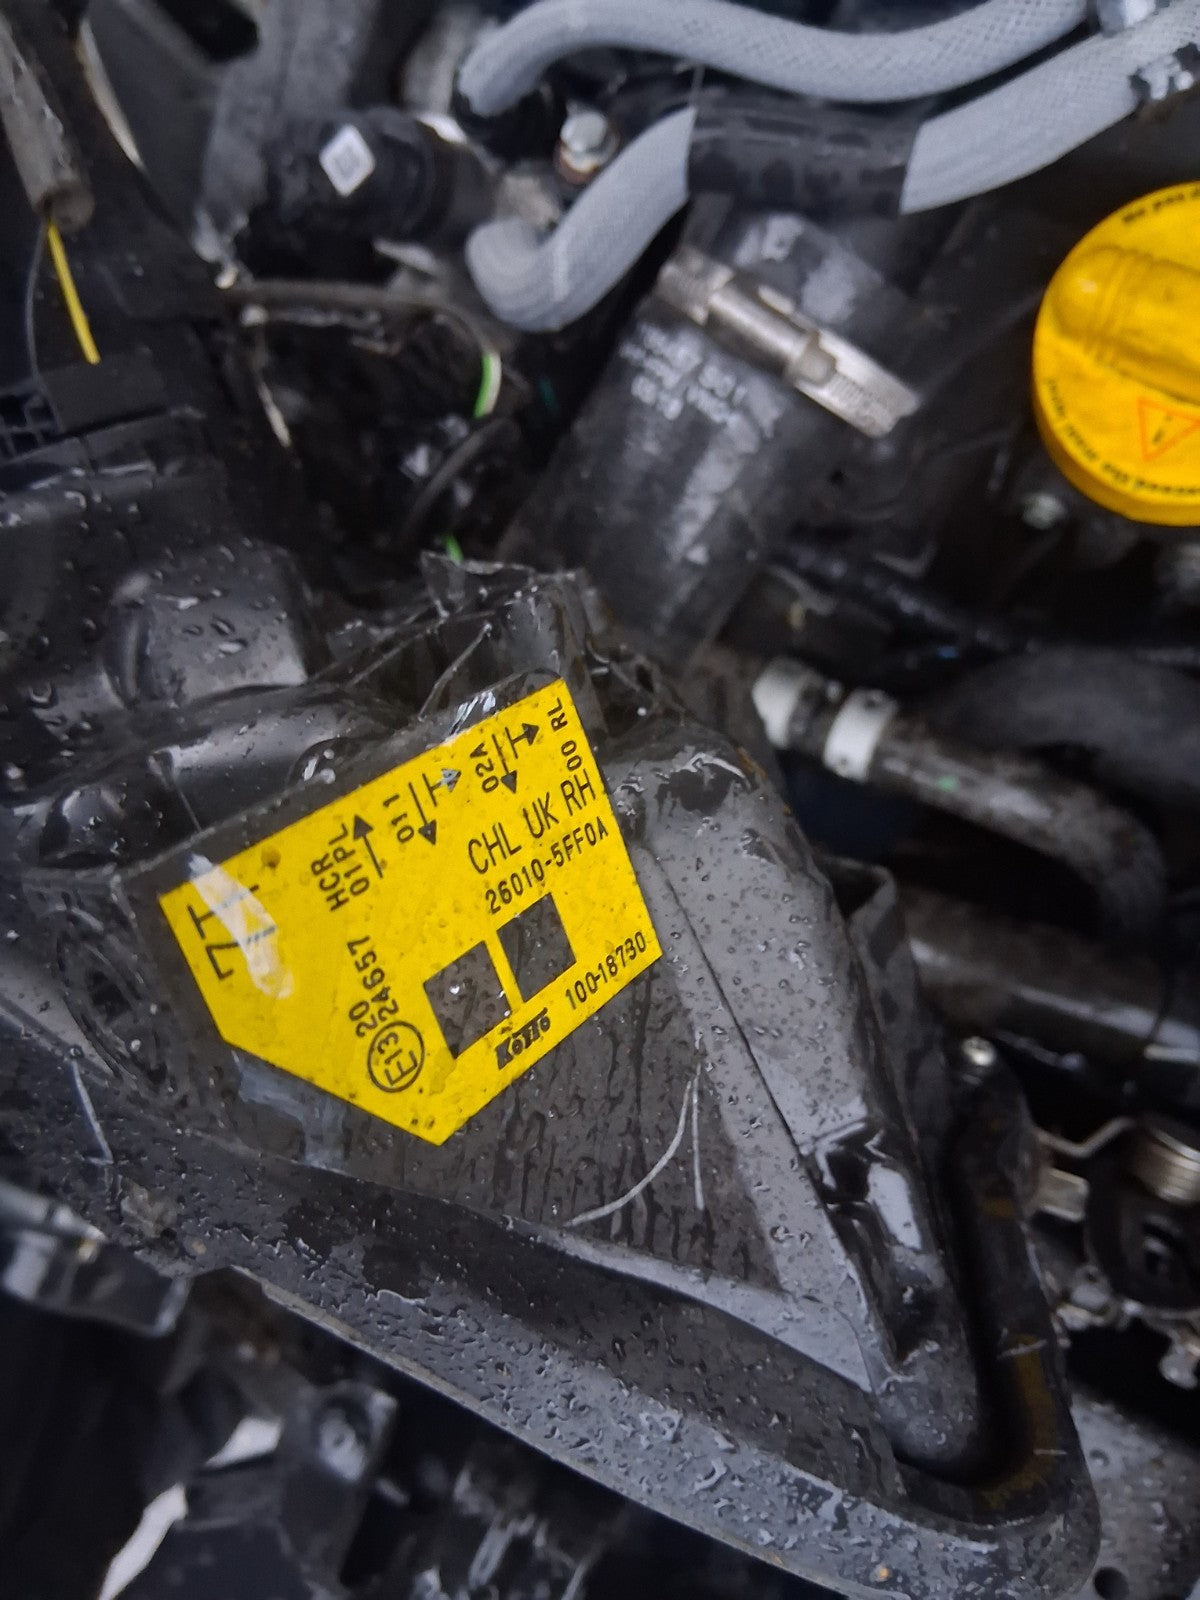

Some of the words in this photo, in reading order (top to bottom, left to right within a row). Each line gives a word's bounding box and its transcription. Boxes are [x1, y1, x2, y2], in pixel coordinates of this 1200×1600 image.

[547, 697, 568, 732] RL
[470, 742, 499, 793] 02A
[561, 740, 583, 772] 00
[468, 822, 522, 875] CHL
[522, 792, 559, 839] UK
[560, 768, 596, 817] RH
[311, 852, 349, 911] HCR
[485, 816, 609, 915] 26010-5FF0A
[347, 935, 398, 1022] 24657
[565, 931, 647, 1010] 100-18730
[349, 1001, 377, 1038] 20
